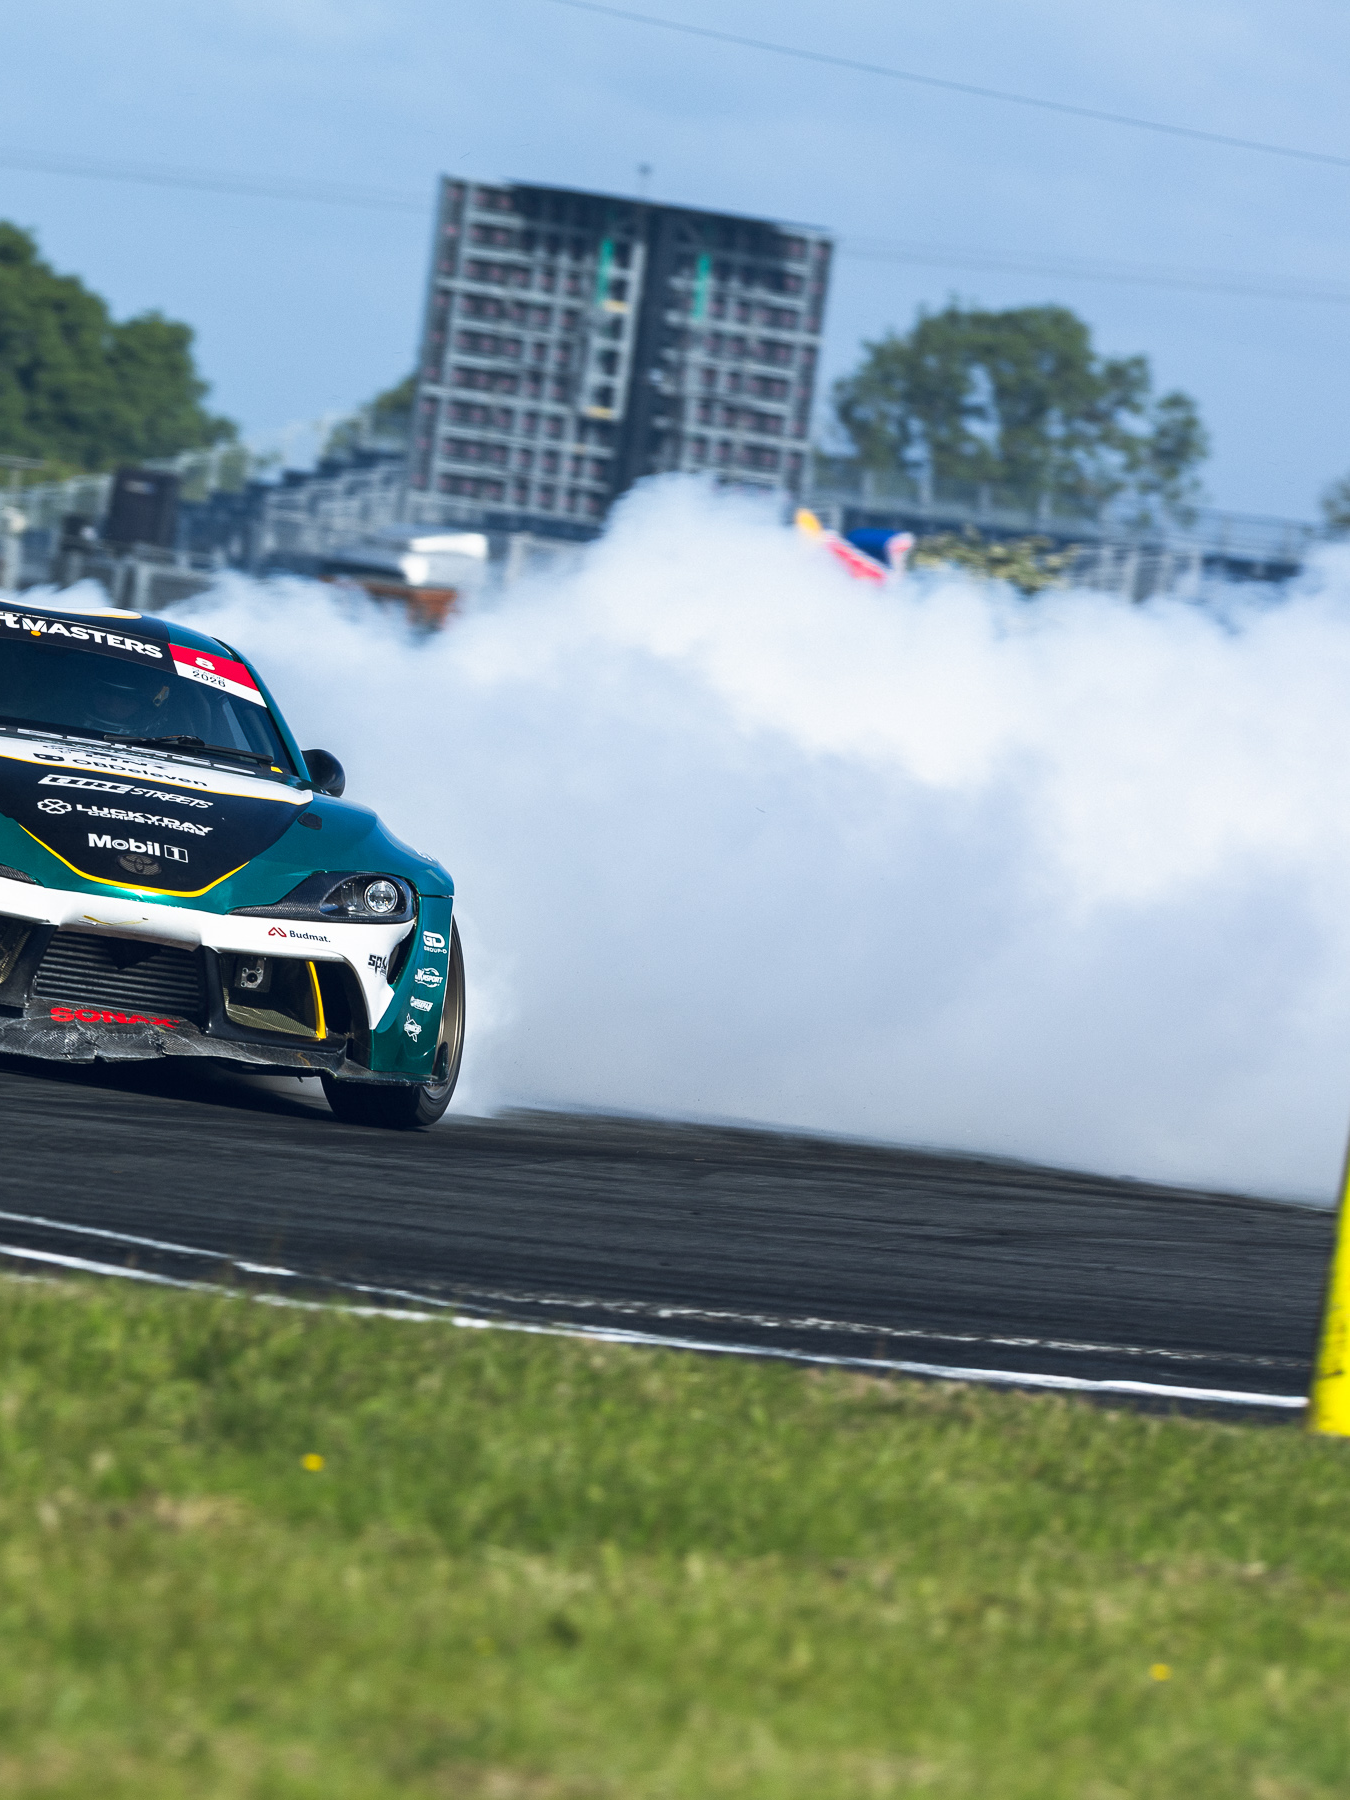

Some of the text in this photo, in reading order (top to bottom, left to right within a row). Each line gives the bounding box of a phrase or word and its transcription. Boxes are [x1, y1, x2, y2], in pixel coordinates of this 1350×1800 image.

[130, 787, 213, 809] STREETS
[87, 833, 161, 857] Mobil
[289, 930, 331, 942] Budmat.
[50, 1007, 179, 1029] SONAX
